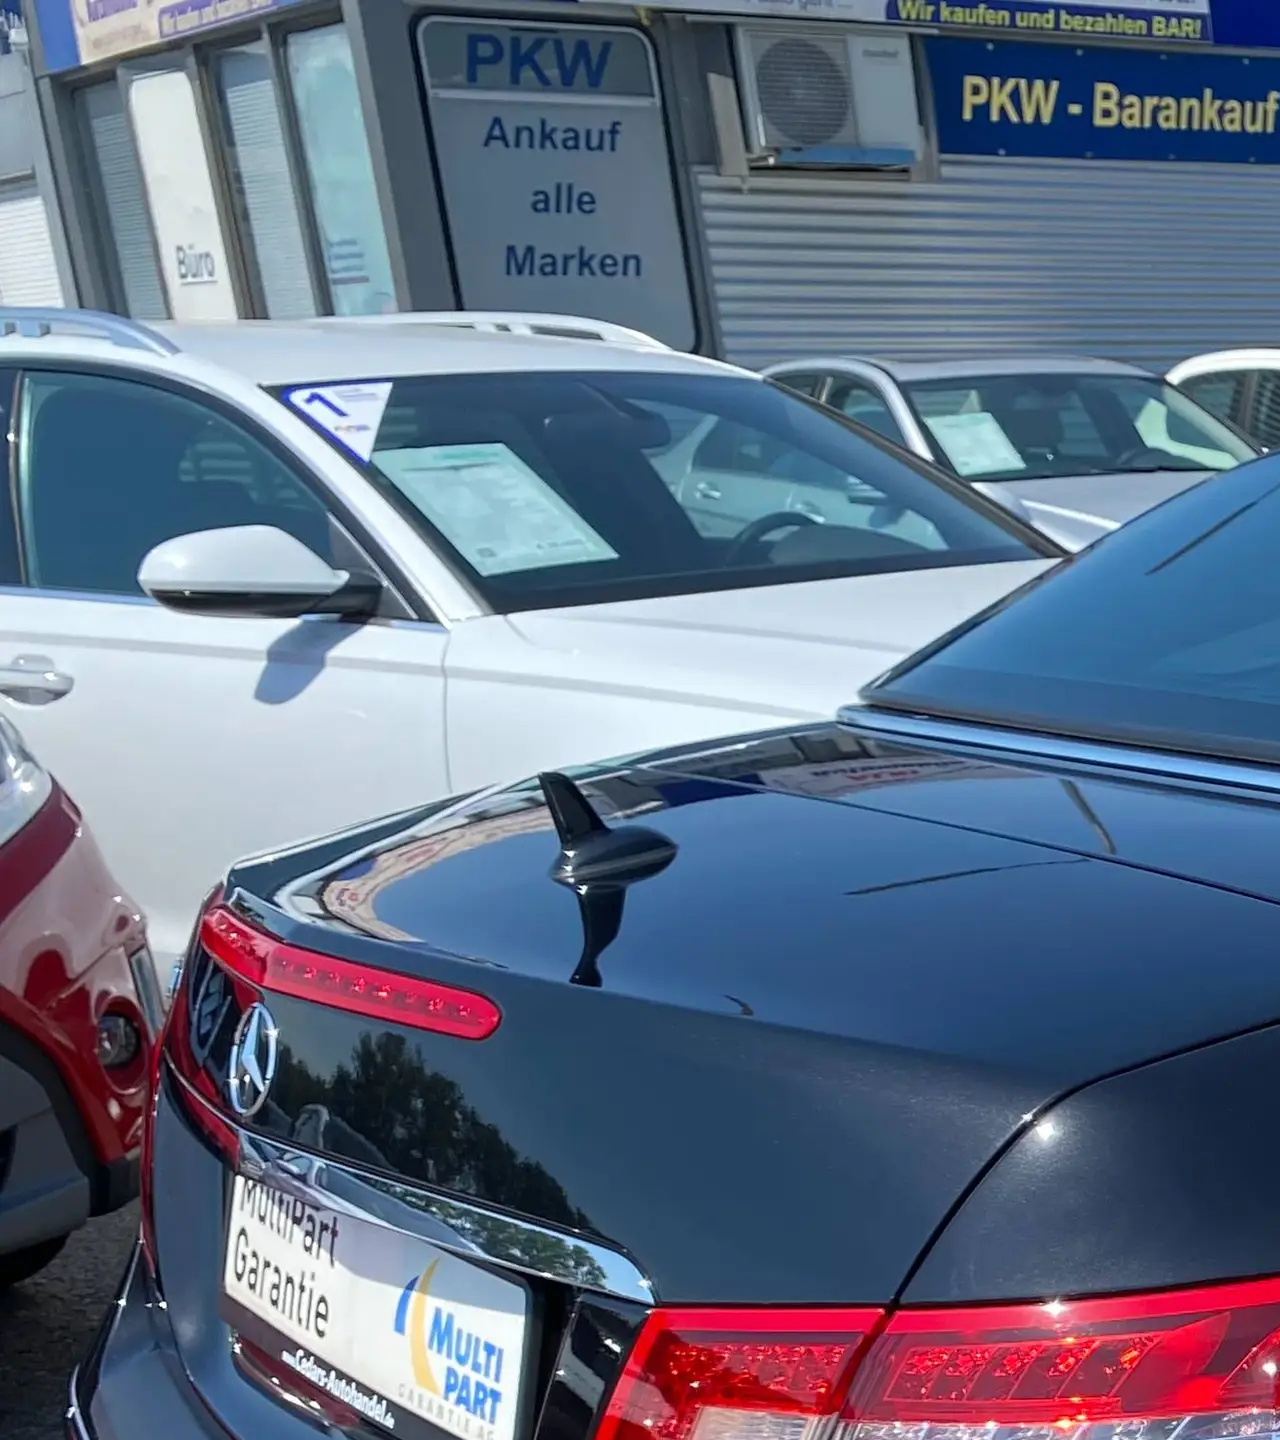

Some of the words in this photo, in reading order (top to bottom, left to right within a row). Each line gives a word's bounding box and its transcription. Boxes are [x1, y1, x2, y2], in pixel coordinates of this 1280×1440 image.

[896, 0, 937, 21] Wir
[939, 1, 1012, 27] kaufen
[1015, 10, 1053, 30] und
[1060, 10, 1147, 36] bezahlen
[1151, 17, 1202, 39] BAR!
[466, 33, 613, 88] PKW
[962, 74, 1060, 125] PKW
[1092, 82, 1280, 133] Barankauf
[483, 116, 622, 152] Ankauf
[531, 182, 597, 214] alle
[175, 243, 216, 280] Büro
[505, 244, 642, 277] Marken
[239, 1178, 339, 1269] MultiPart
[234, 1227, 330, 1339] Garantie
[428, 1306, 504, 1384] MULTI
[397, 1383, 471, 1434] GARANTIE
[443, 1366, 503, 1425] PART
